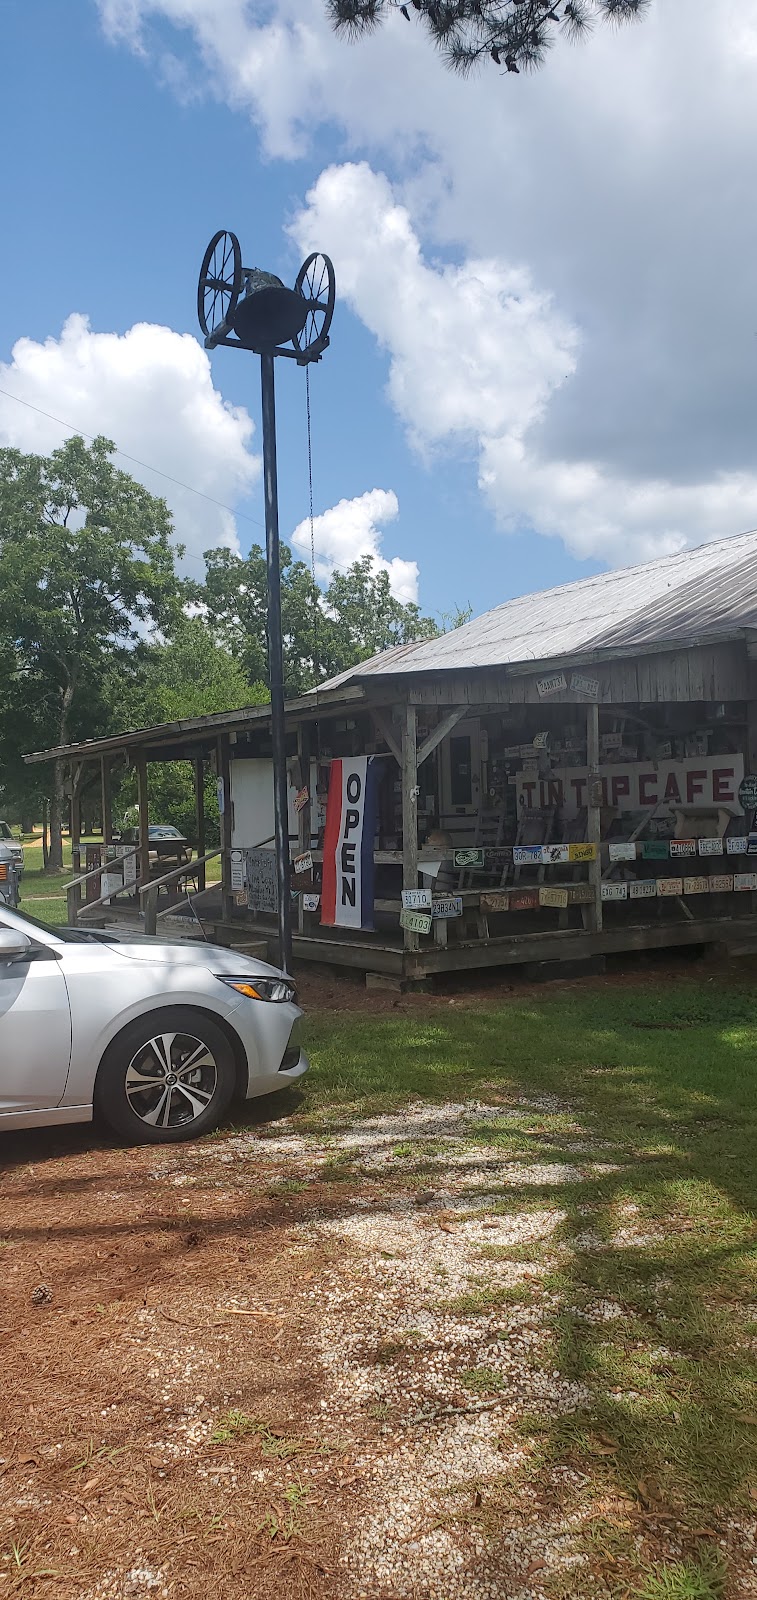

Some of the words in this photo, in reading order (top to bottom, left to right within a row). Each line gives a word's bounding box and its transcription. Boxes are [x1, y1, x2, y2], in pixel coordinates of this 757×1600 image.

[522, 779, 564, 808] TIN
[638, 767, 735, 805] CAFE
[341, 772, 362, 907] OPEN
